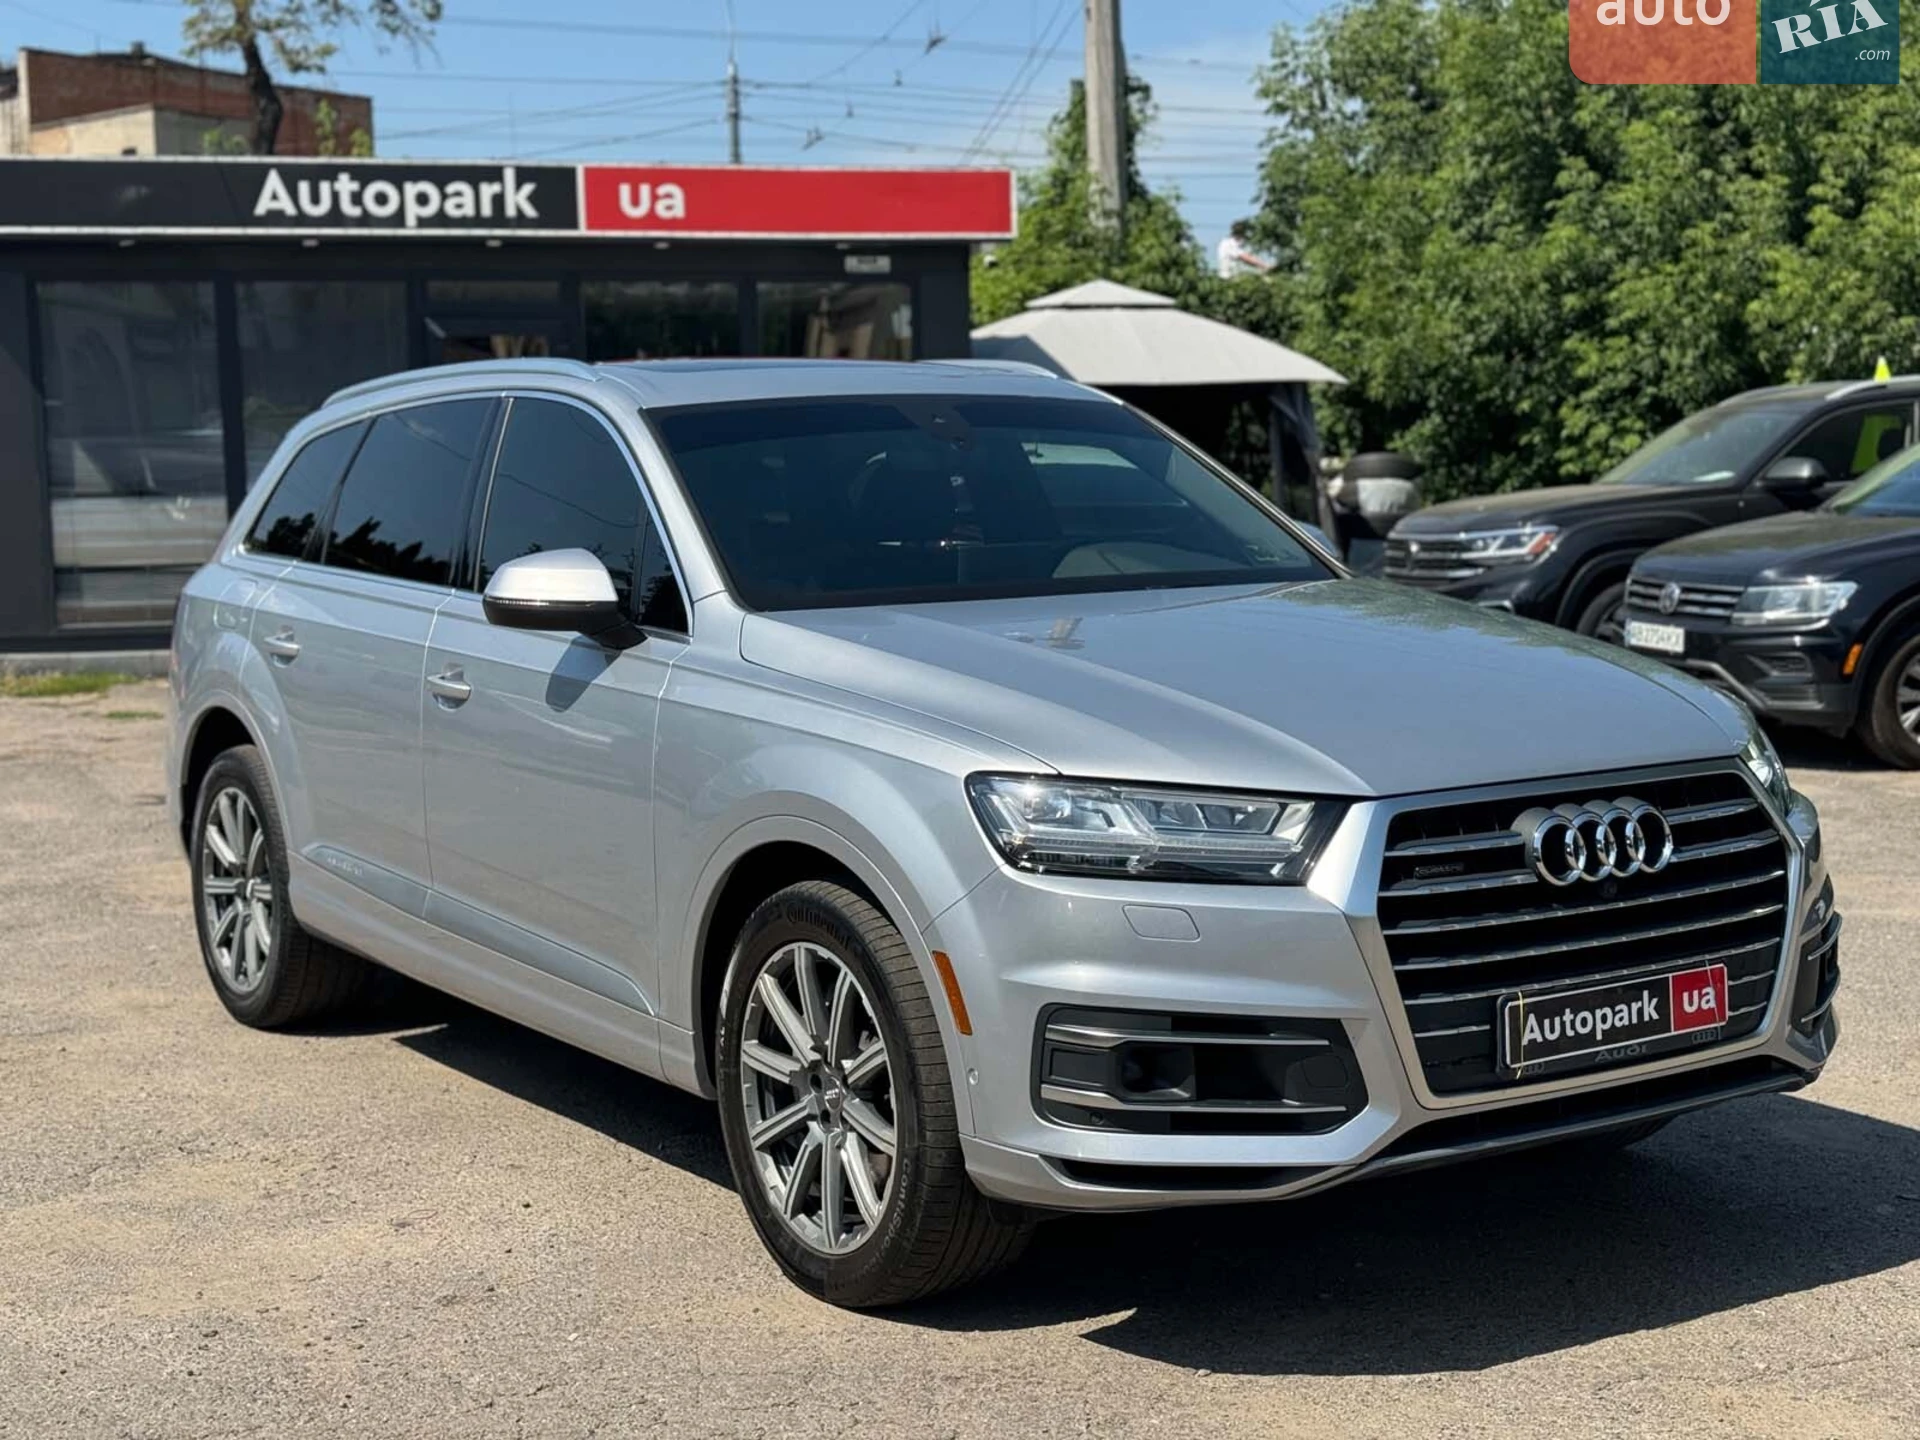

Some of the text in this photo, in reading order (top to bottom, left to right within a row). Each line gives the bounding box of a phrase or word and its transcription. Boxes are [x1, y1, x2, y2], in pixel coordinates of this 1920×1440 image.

[254, 166, 687, 229] Autopark ua
[1522, 986, 1717, 1041] Autopark ua
[1594, 1043, 1647, 1063] Audi
